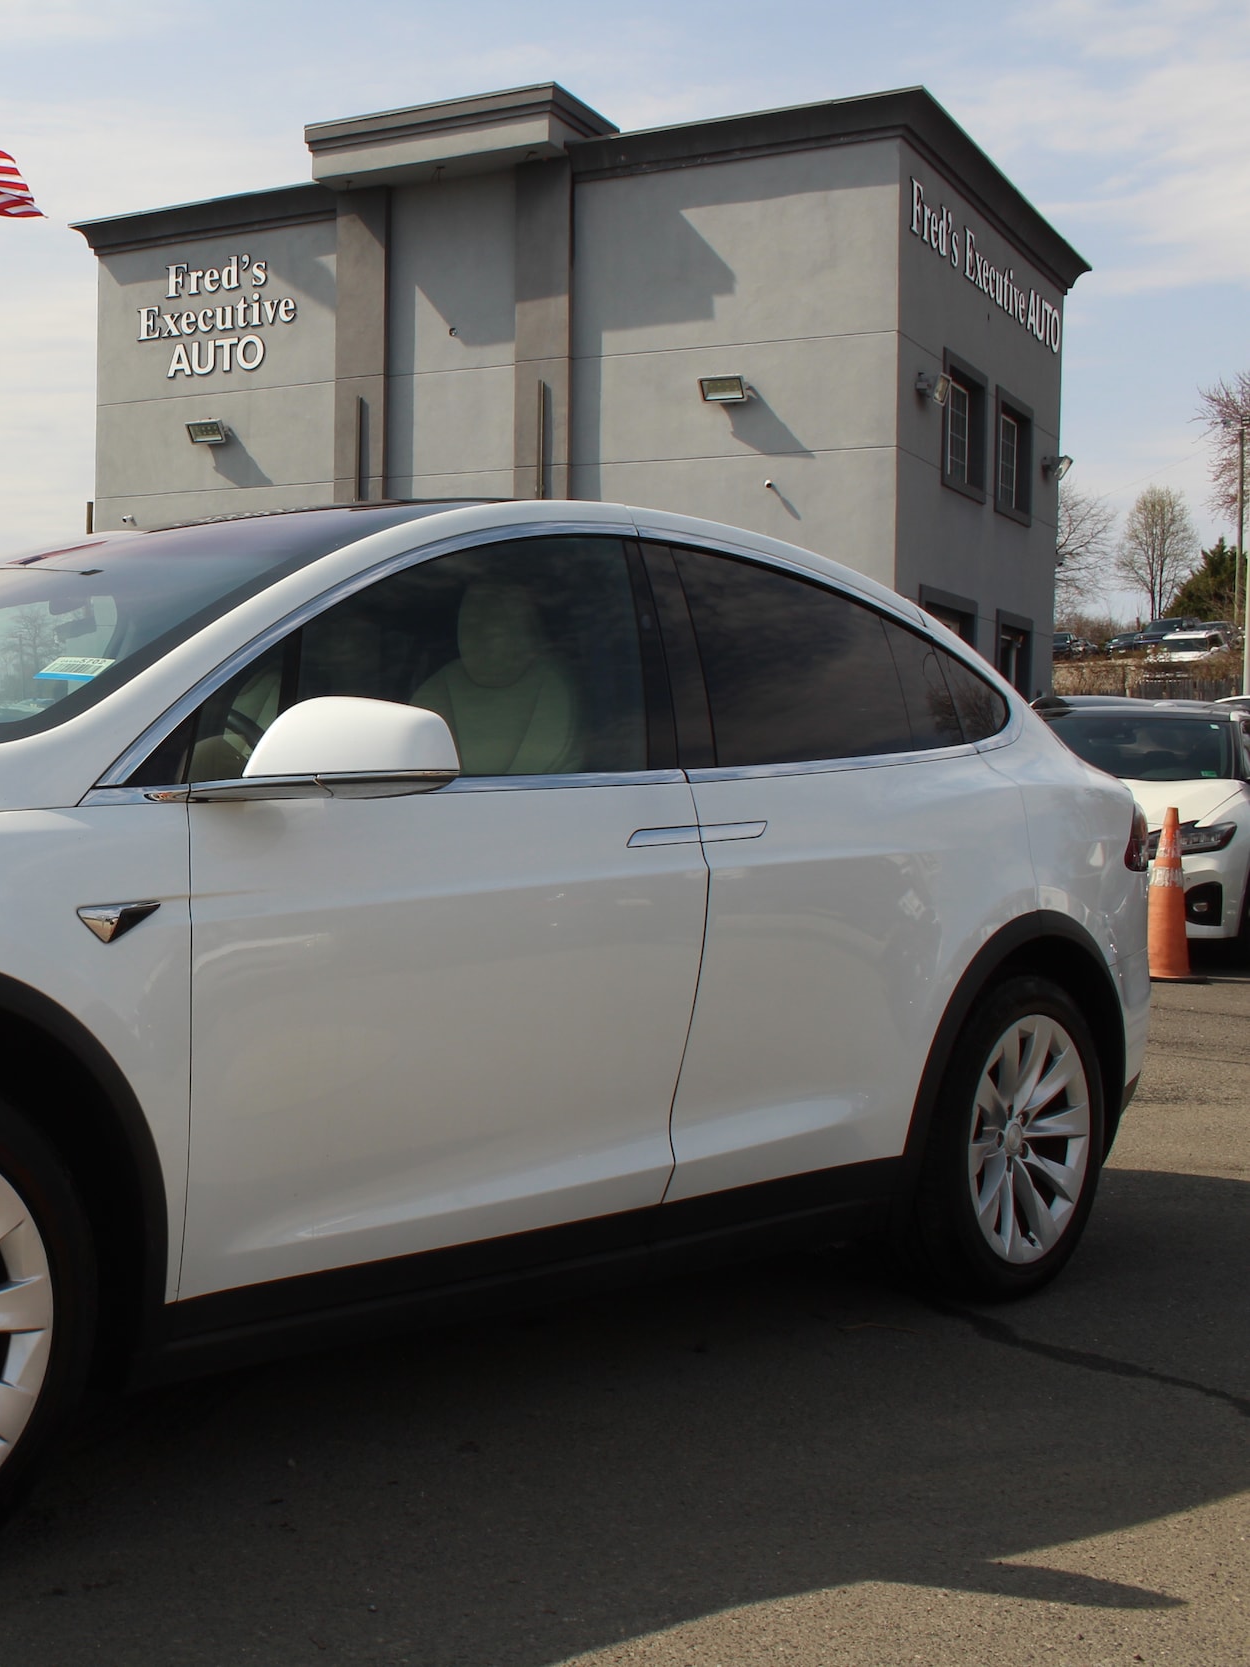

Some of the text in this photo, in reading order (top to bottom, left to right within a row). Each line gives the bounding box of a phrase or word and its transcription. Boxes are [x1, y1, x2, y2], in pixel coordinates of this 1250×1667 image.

[166, 254, 267, 298] Fred's
[910, 176, 1060, 353] Fred's Executive AUTO
[137, 293, 296, 341] Executive
[167, 334, 265, 378] AUTO
